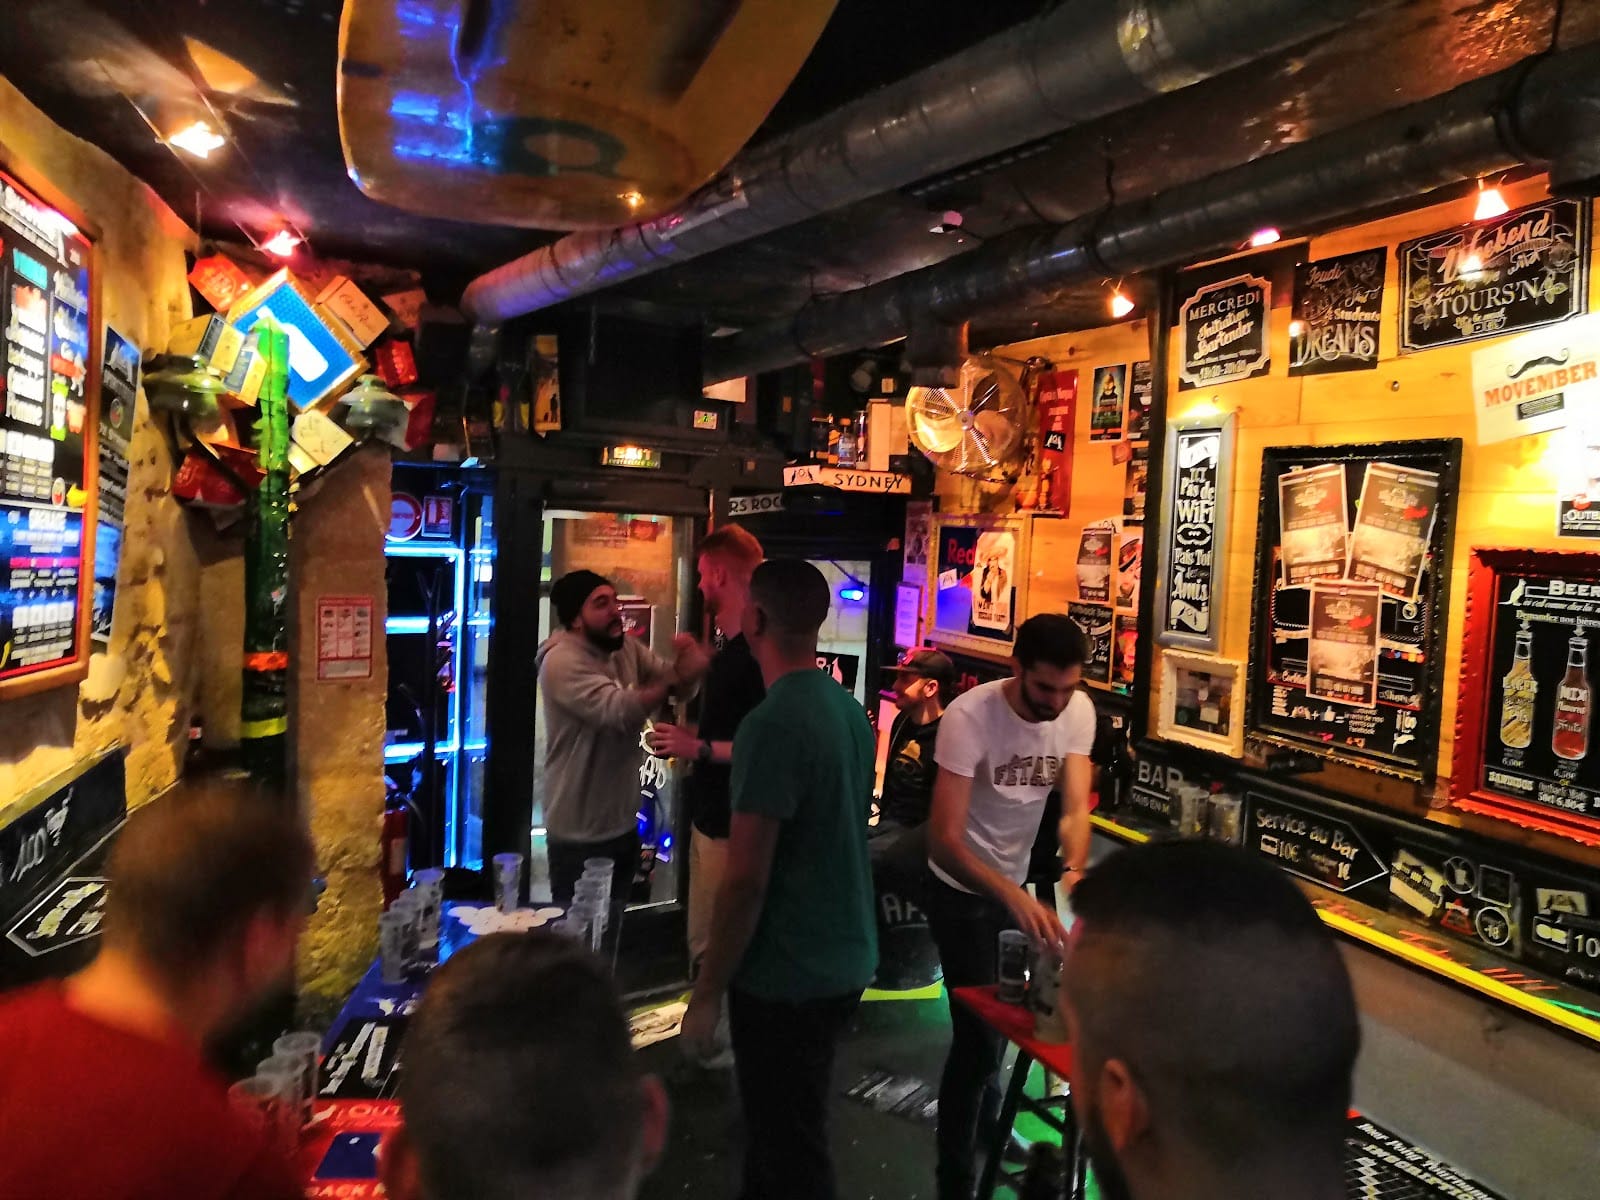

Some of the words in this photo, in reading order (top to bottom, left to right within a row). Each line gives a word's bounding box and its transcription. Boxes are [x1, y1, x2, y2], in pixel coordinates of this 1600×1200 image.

[1189, 290, 1260, 321] MERCREDI
[1296, 322, 1376, 363] DREAMS
[1483, 361, 1598, 408] MOVEMBER
[834, 473, 903, 490] SYDNEY
[1256, 808, 1306, 836] Service
[1309, 826, 1329, 844] au
[1331, 829, 1359, 860] Bar
[1574, 934, 1600, 958] 10
